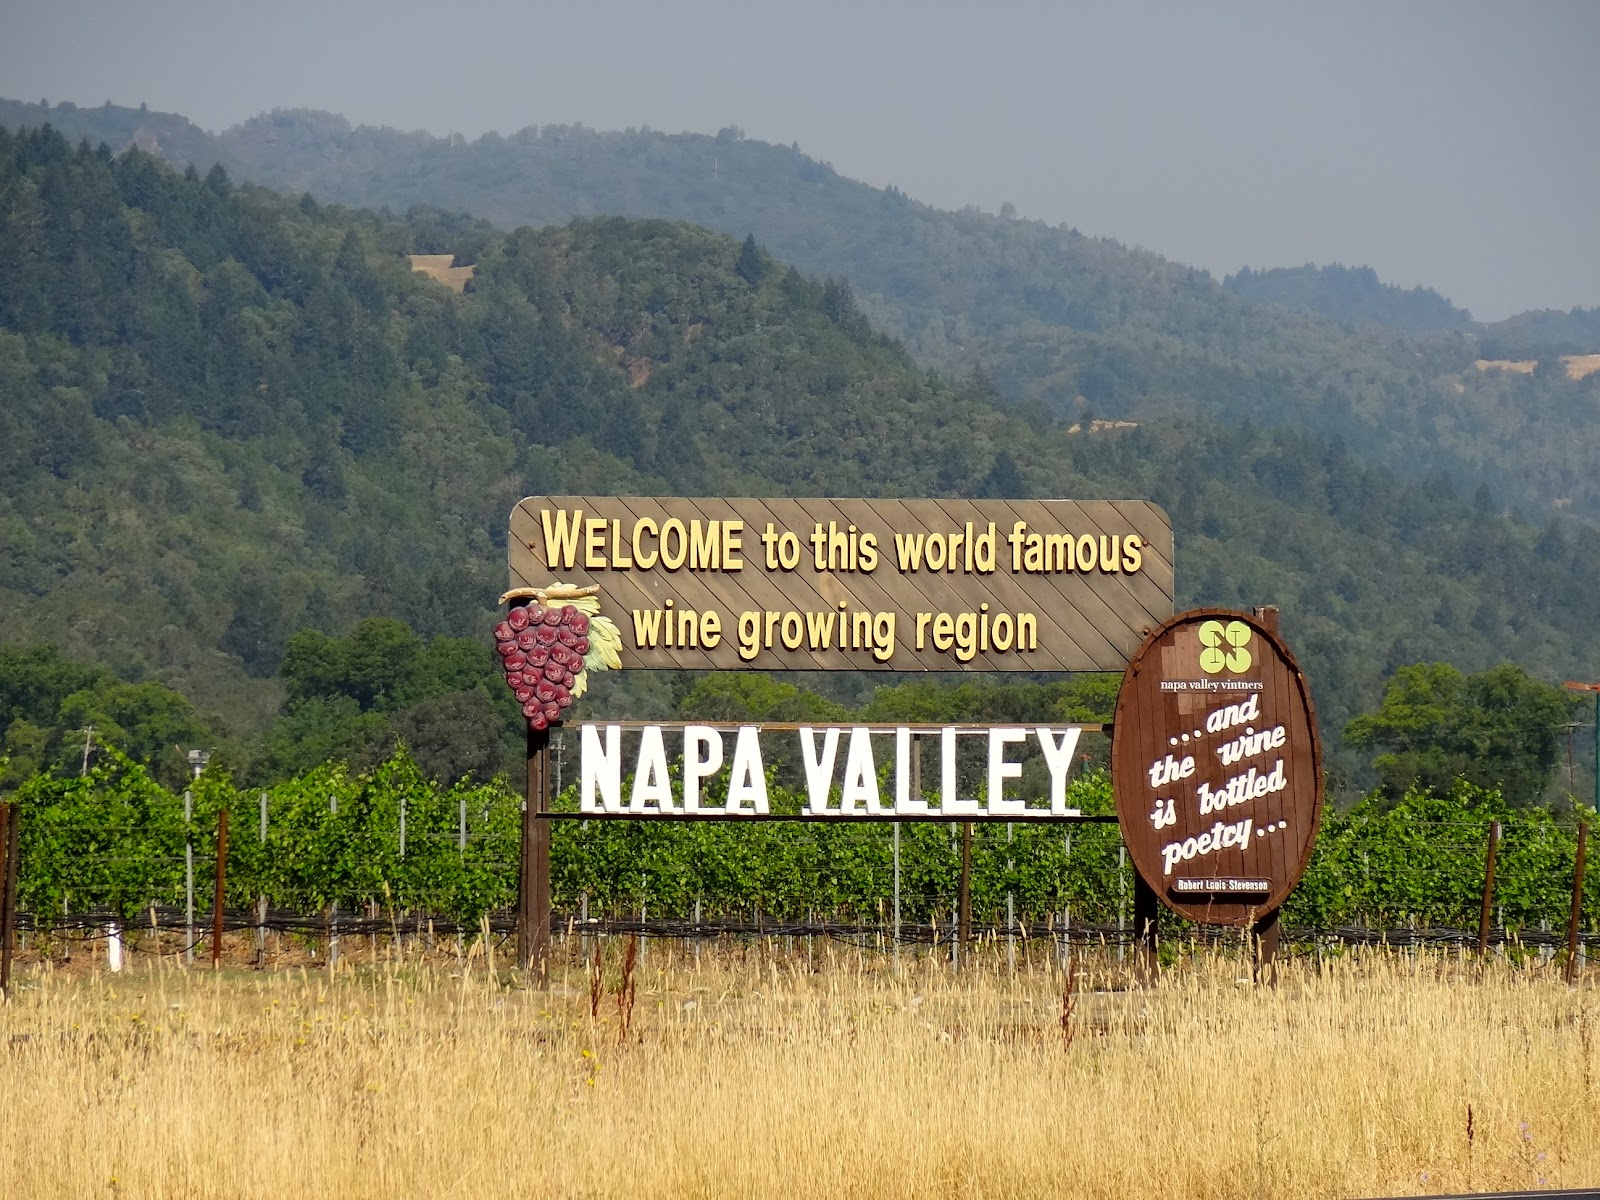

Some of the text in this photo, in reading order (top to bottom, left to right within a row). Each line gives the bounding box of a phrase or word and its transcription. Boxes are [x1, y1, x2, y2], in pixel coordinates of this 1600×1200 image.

[540, 509, 1142, 573] WELCOME to this world famous
[632, 598, 1037, 661] wine growing region
[1160, 679, 1263, 692] napa valley vintners
[580, 724, 1082, 816] NAPA VALLEY
[1148, 724, 1286, 788] the wine
[1150, 760, 1288, 830] is bottled
[1178, 879, 1268, 891] Robert Louis Stevenson
